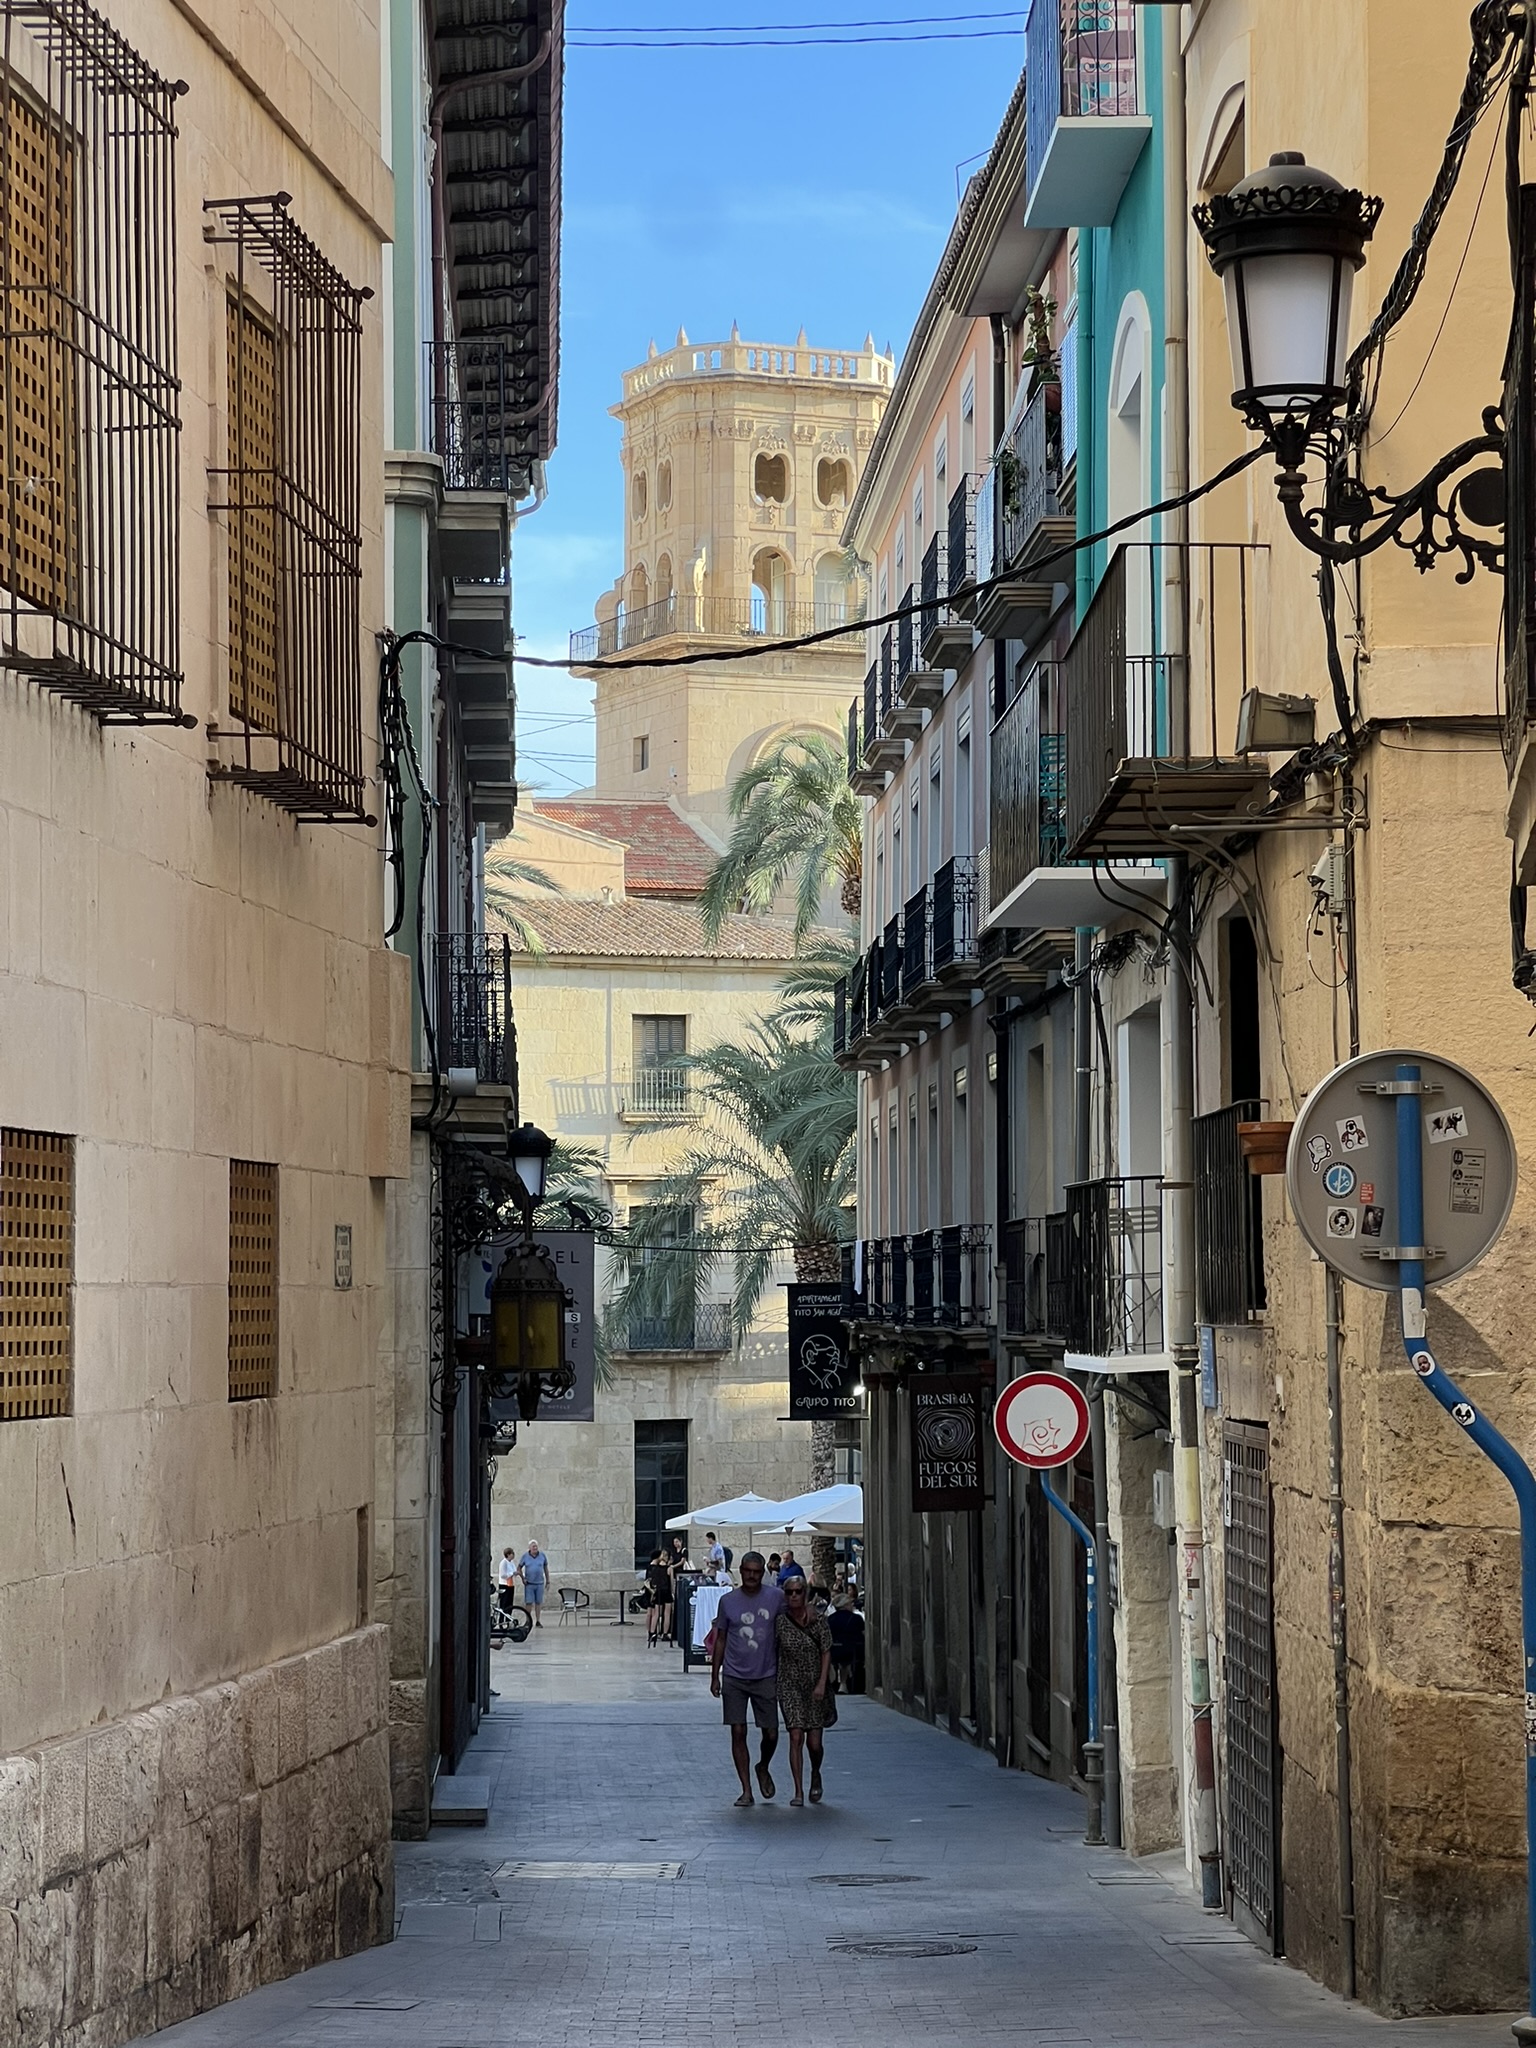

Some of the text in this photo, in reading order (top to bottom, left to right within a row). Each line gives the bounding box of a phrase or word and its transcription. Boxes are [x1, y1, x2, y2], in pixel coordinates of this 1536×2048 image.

[794, 1308, 812, 1317] TITO
[795, 1396, 856, 1409] GRUPO TITO
[919, 1460, 977, 1475] FUEGOS
[919, 1474, 978, 1489] DEL SUR
